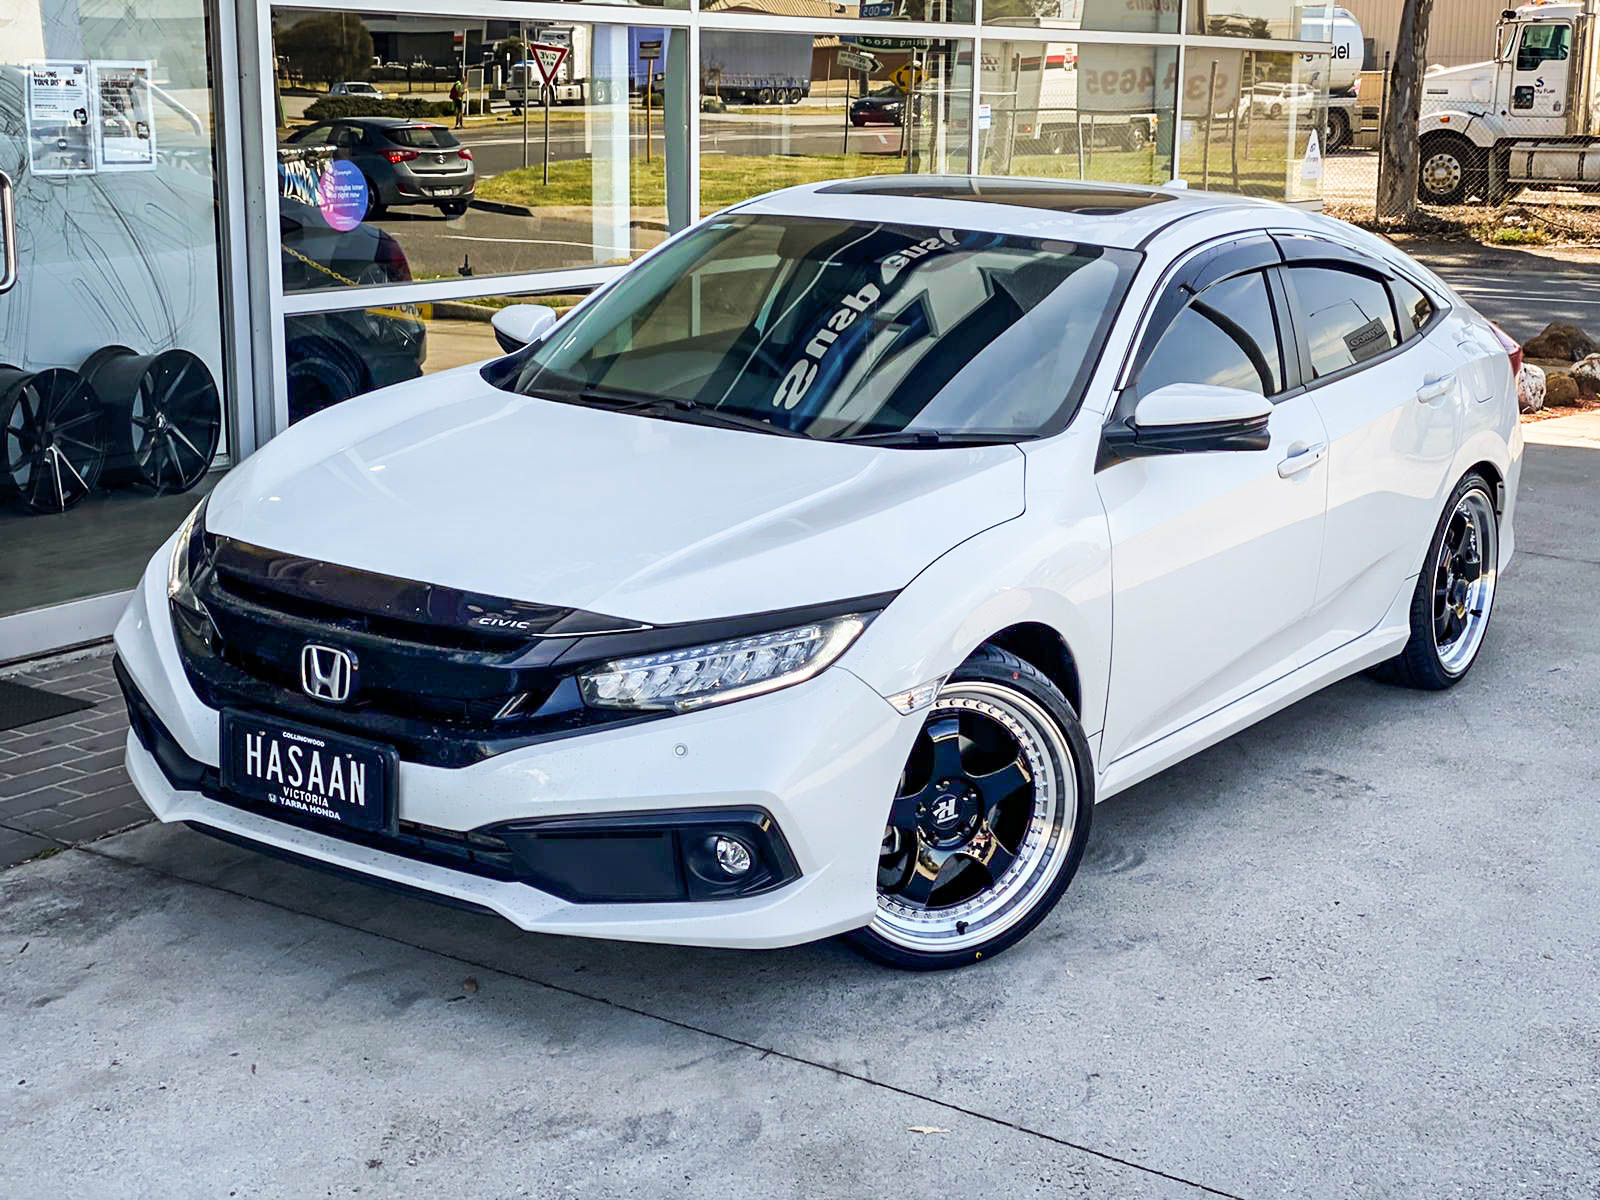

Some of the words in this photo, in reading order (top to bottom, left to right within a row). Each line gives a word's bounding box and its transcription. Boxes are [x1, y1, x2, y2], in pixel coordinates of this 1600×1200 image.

[479, 617, 530, 629] CIVIC
[282, 731, 325, 748] COLLINGWOOD
[246, 733, 366, 806] HASAAN
[279, 796, 309, 812] YARRA
[309, 804, 341, 820] HONDA
[283, 786, 329, 808] VICTORIA
